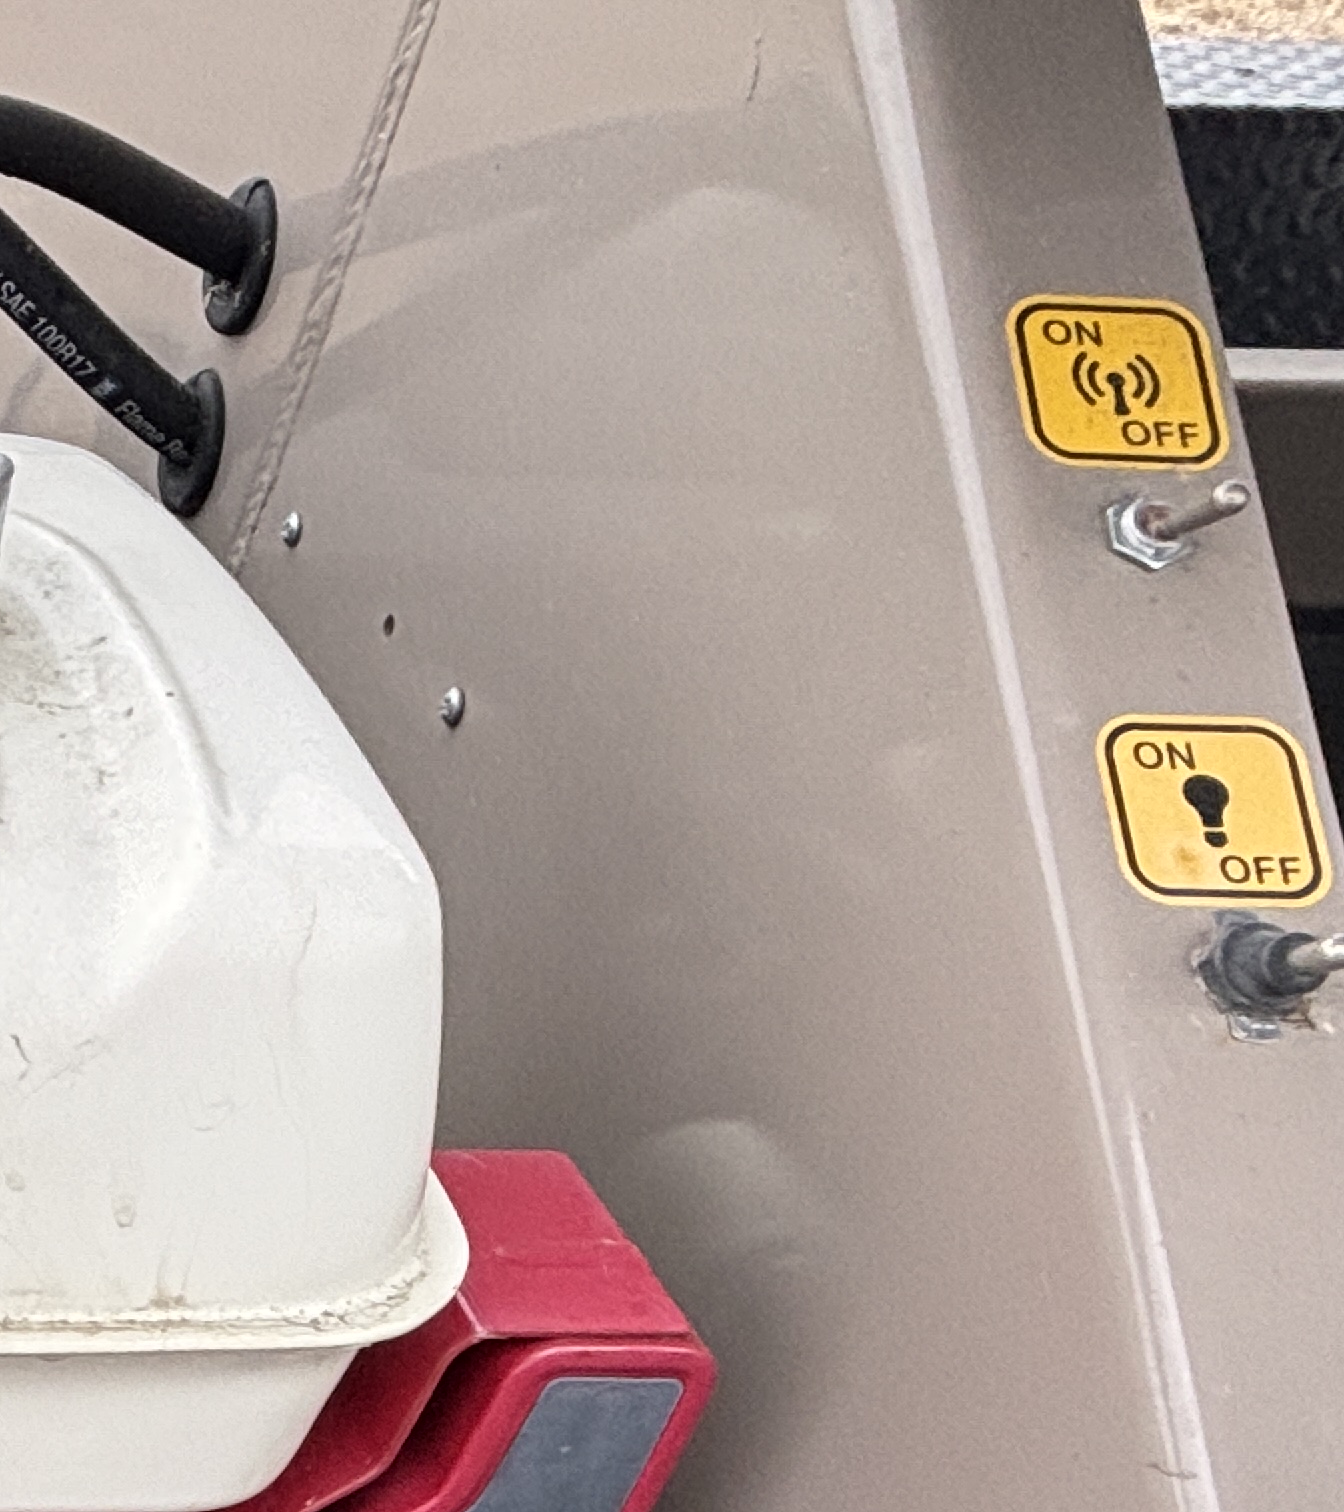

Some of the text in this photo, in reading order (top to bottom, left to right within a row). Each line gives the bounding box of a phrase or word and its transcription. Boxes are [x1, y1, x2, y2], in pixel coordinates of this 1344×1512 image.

[30, 316, 97, 377] 100R17
[1042, 319, 1103, 347] ON
[1121, 420, 1200, 448] OFF
[1132, 741, 1196, 770] ON
[1219, 855, 1301, 885] OFF
